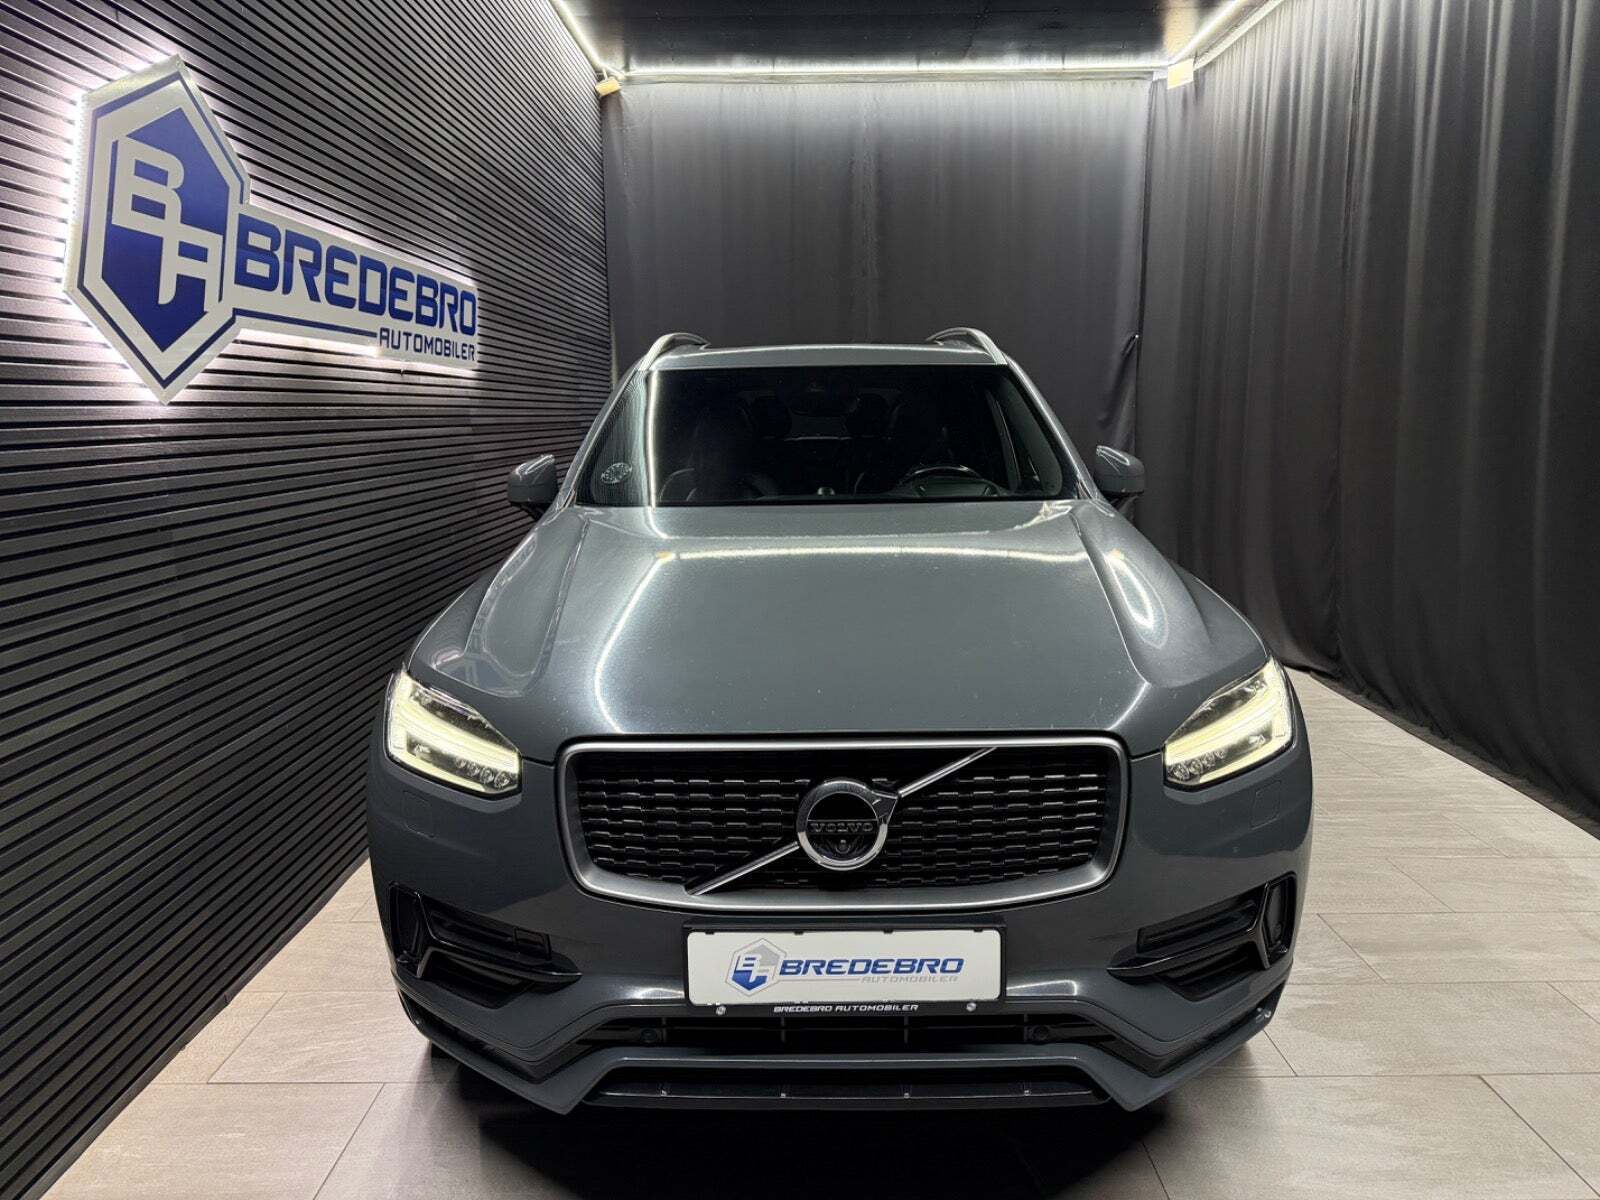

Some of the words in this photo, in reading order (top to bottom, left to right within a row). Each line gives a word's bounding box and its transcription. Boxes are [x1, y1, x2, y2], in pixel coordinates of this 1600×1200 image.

[234, 212, 477, 337] BREDEBRO
[378, 326, 477, 362] AUTOMOBILER
[810, 822, 874, 833] VOLVO
[779, 957, 965, 976] BREDEBRO
[860, 975, 959, 983] AUTOMOBILER
[773, 1004, 833, 1013] BREDEBRO
[834, 1003, 919, 1012] AUTOMOBILER
